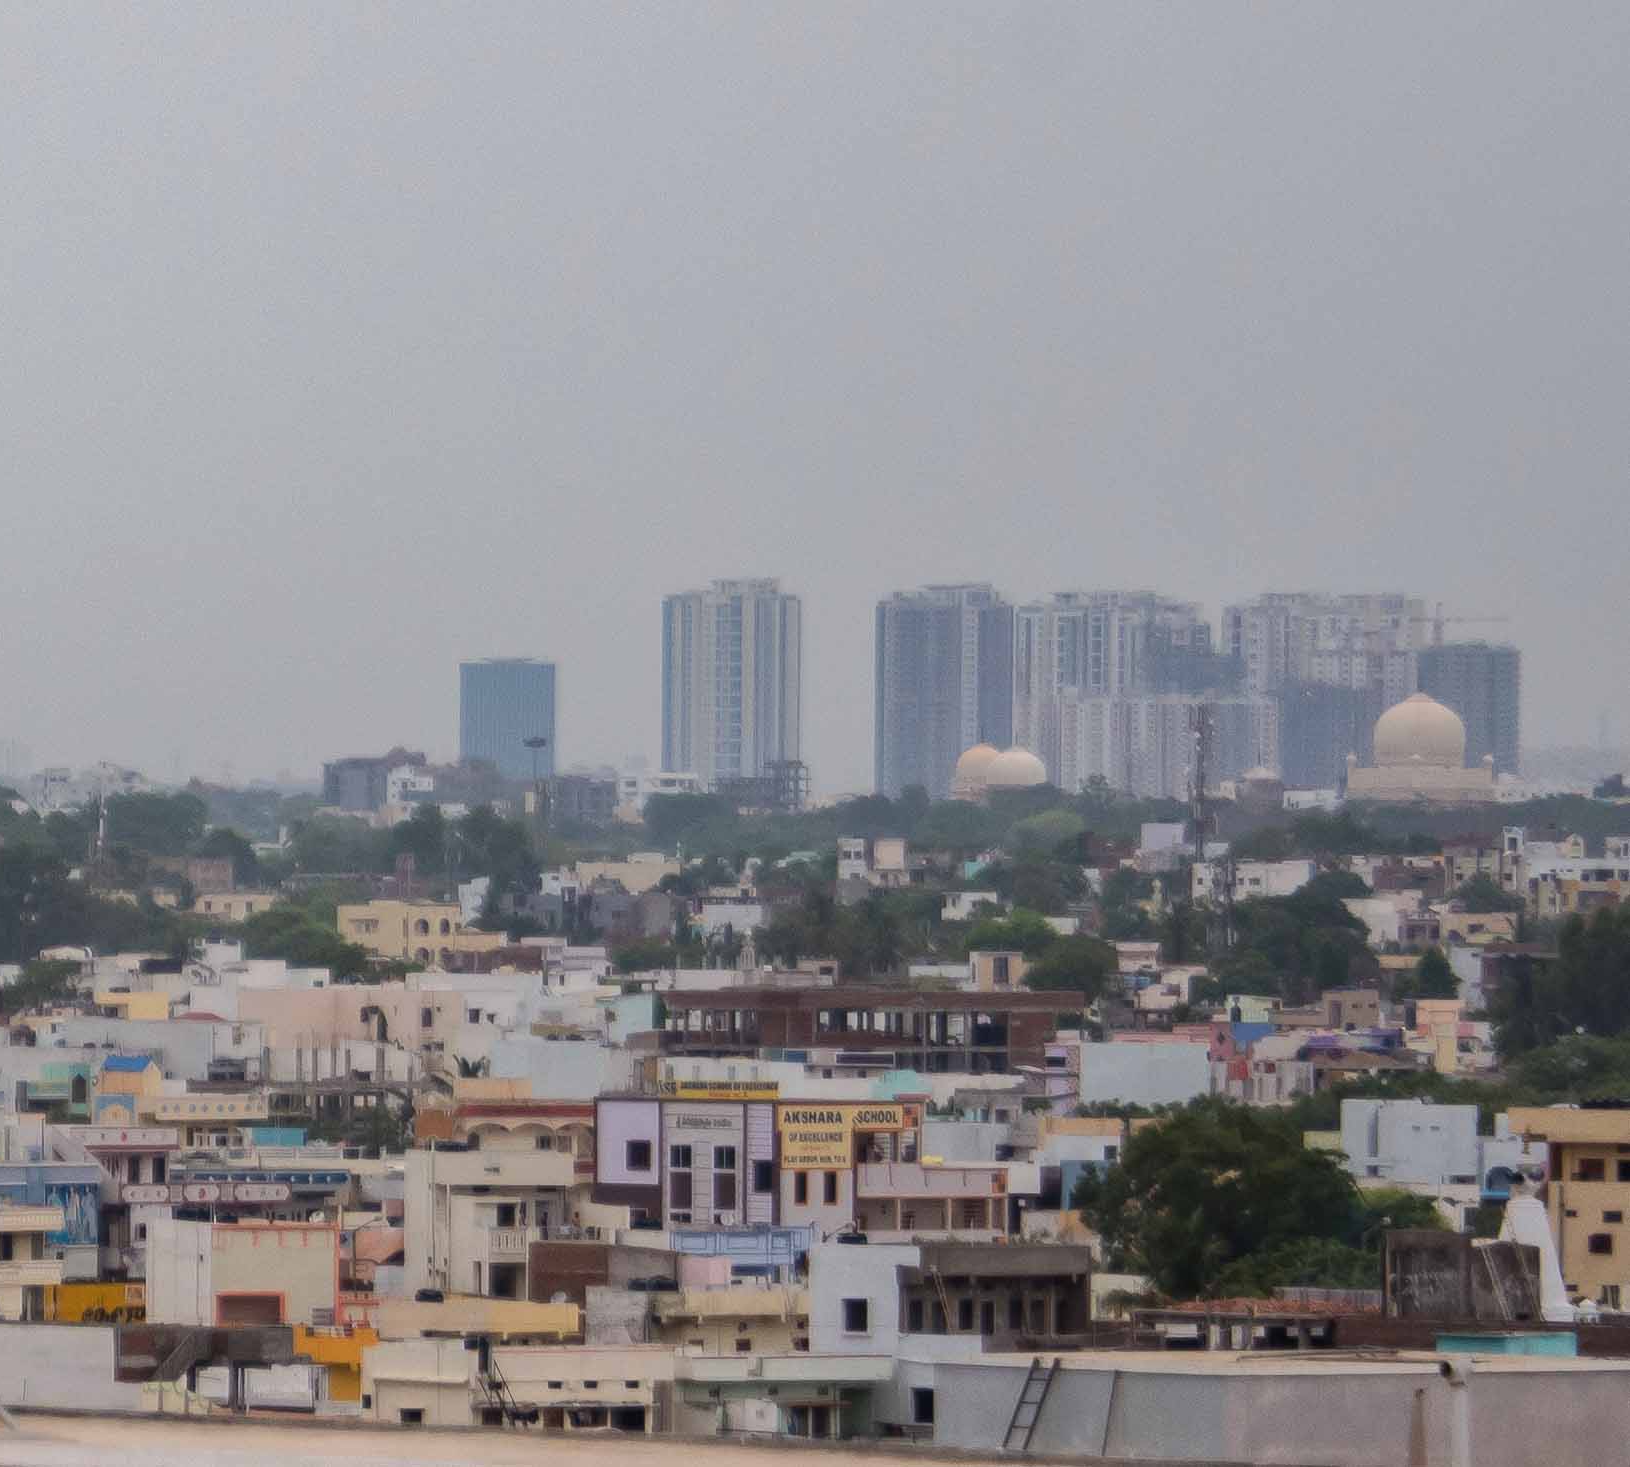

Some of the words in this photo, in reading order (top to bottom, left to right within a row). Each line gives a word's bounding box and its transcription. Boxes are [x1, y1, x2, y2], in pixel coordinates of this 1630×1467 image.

[784, 1111, 843, 1124] AKSHARA
[857, 1110, 898, 1123] SCHOOL
[789, 1132, 798, 1142] OF
[800, 1132, 843, 1142] EXCELLENCE
